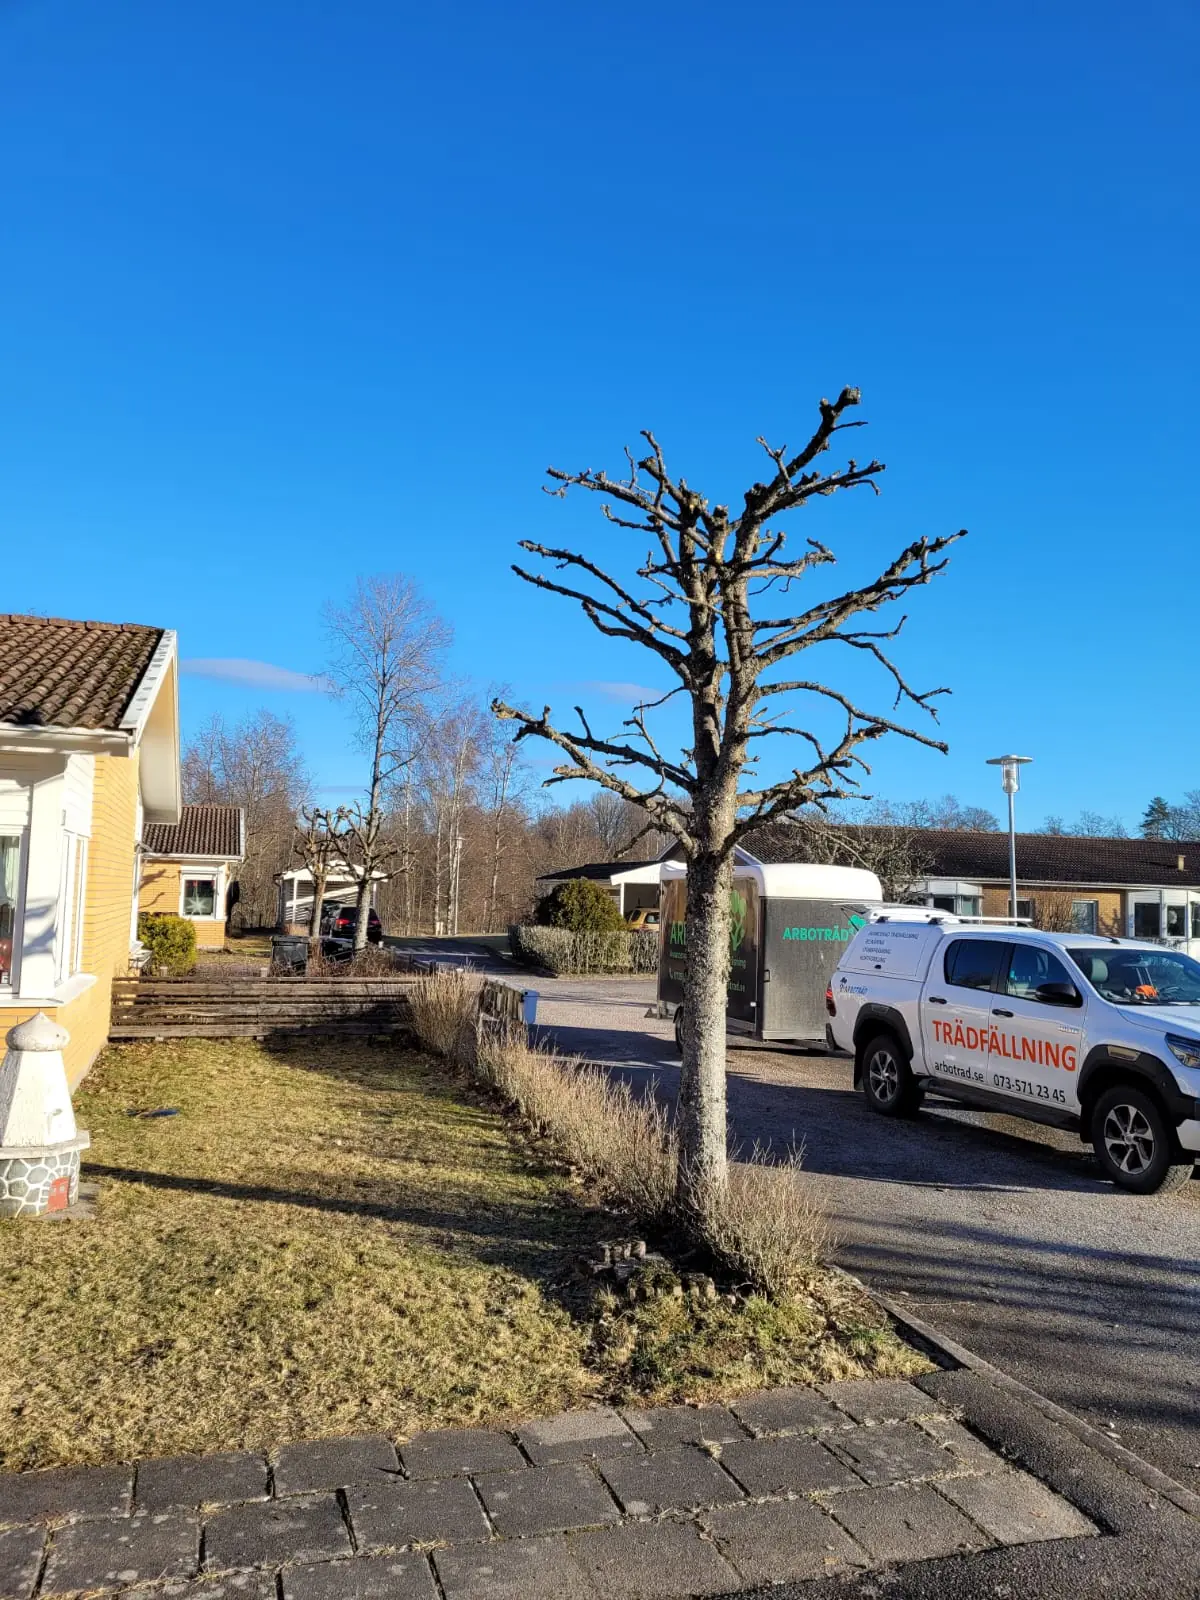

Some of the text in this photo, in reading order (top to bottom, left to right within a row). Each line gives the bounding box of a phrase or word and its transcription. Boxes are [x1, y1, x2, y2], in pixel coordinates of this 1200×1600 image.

[783, 924, 849, 941] ARBOTRÄD
[932, 1018, 1077, 1072] TRÄDFÄLLNING
[934, 1060, 1066, 1103] arbotrad.se 073-571 23 45
